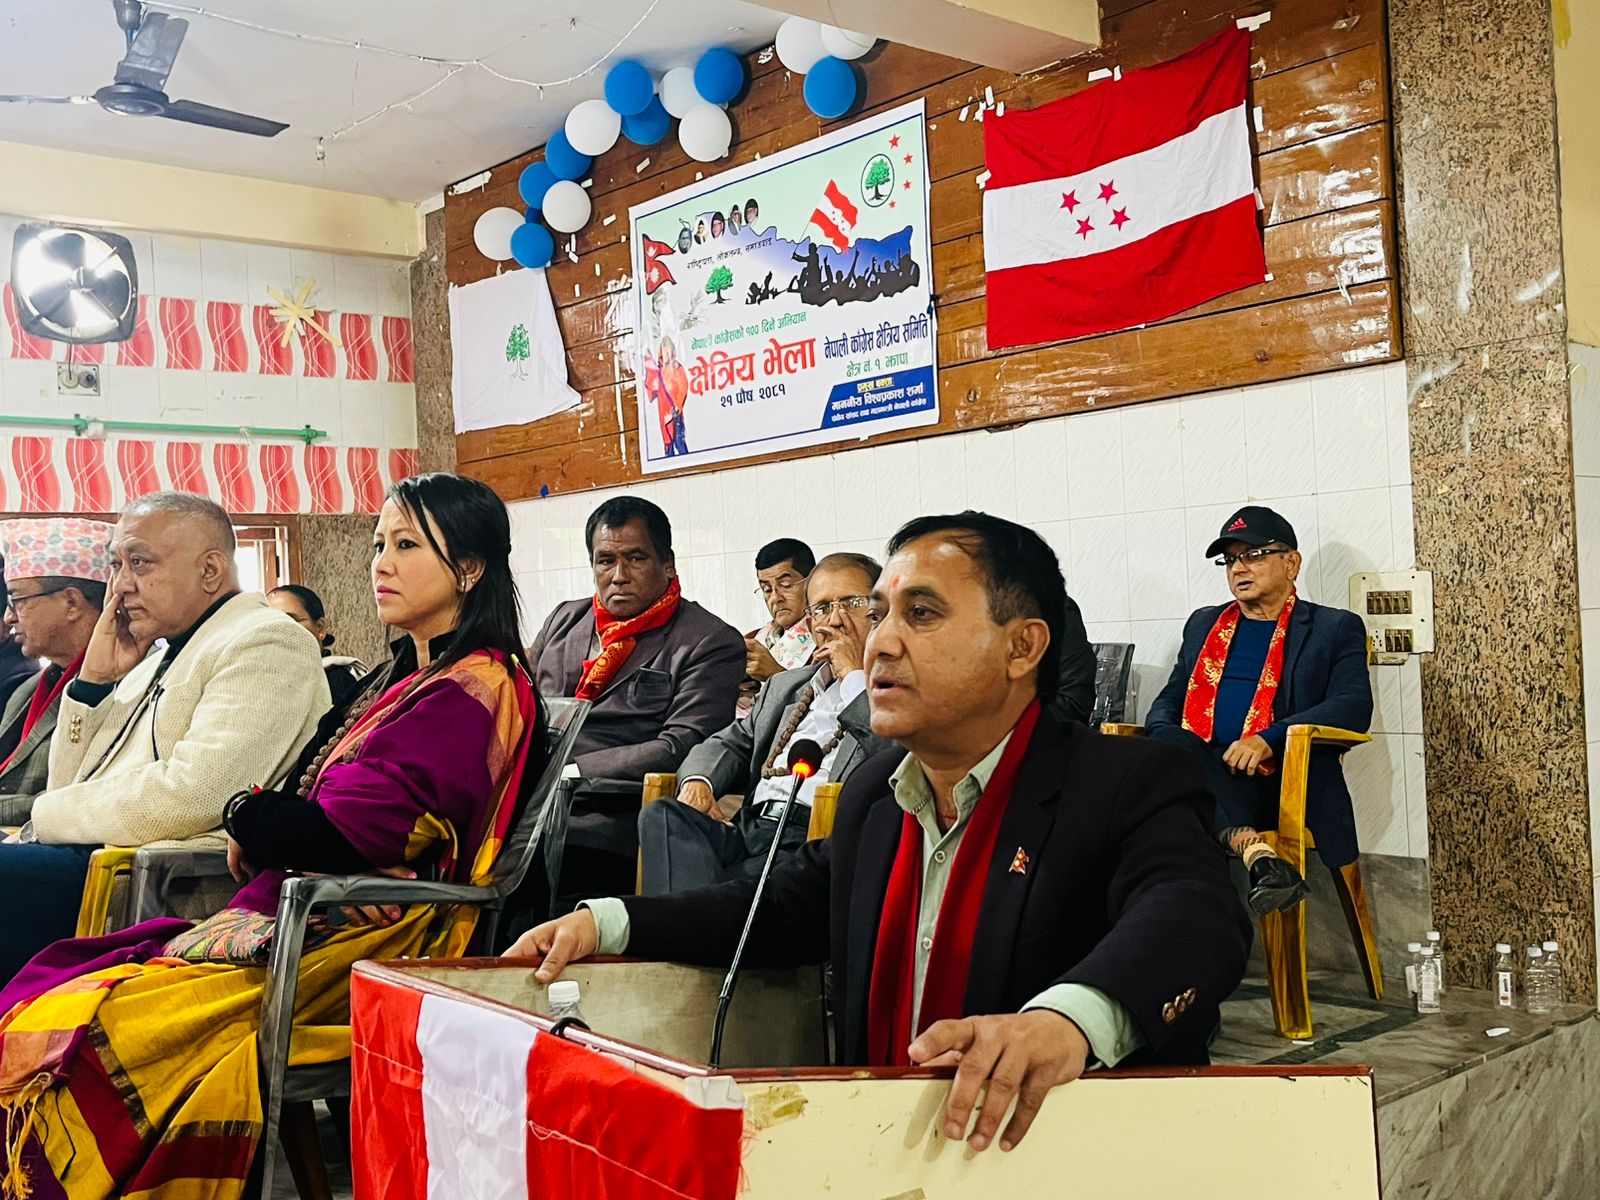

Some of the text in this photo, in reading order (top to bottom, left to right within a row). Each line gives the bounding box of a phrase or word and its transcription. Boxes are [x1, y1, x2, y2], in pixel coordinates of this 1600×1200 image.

[746, 325, 759, 337] १००
[777, 311, 806, 329] अभियान
[824, 332, 849, 360] नेपाली
[876, 321, 900, 349] क्षेत्रिय
[902, 313, 928, 343] समिति
[688, 338, 816, 396] क्षेत्रिय भेला
[846, 360, 861, 378] क्षेत्र
[874, 358, 881, 370] १
[885, 352, 909, 368] झापा
[720, 395, 733, 408] २१
[759, 383, 786, 400] २०८१
[831, 395, 862, 411] माननीय
[906, 382, 924, 397] शर्मा
